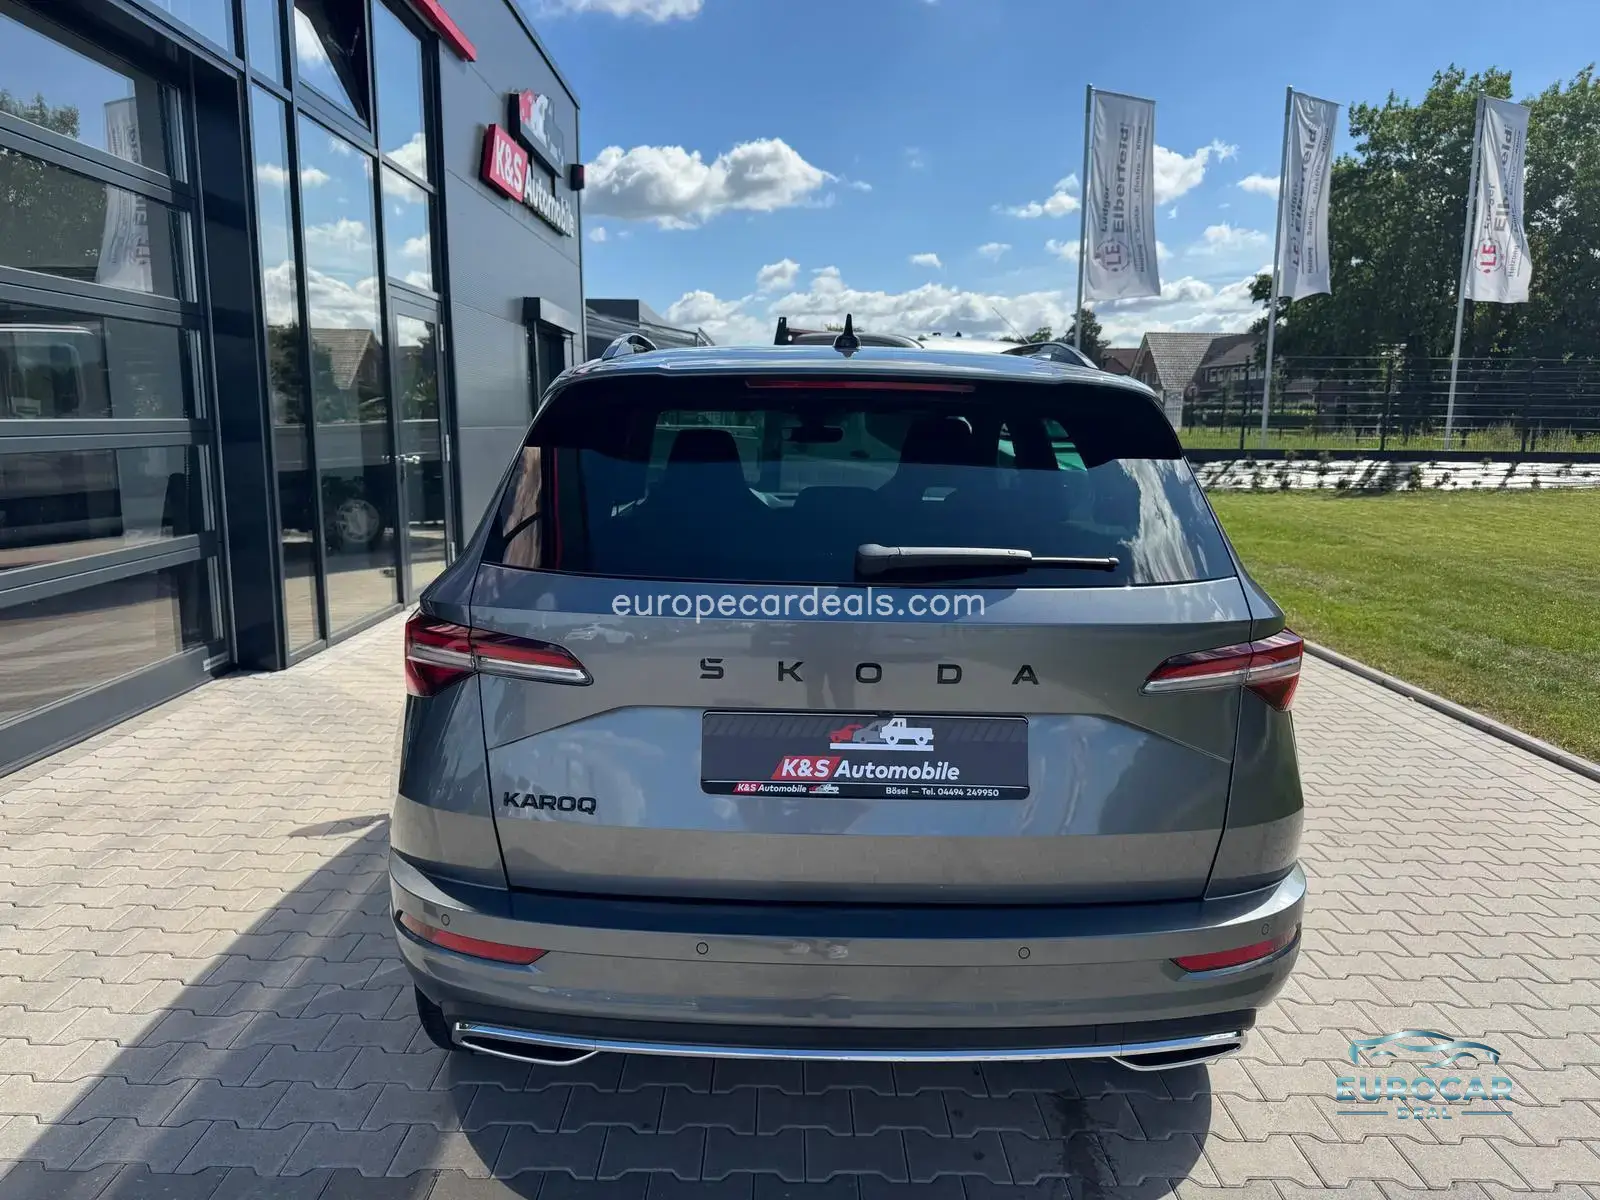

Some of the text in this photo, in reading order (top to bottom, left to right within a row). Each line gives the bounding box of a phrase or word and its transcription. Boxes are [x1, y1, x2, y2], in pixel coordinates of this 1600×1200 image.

[494, 134, 575, 238] K&S Automobile
[1112, 127, 1129, 234] Elberfeld
[1480, 244, 1497, 267] LE
[781, 758, 960, 781] K&S Automobile
[736, 783, 807, 793] K&S Automobile
[885, 786, 909, 796] Bösel
[921, 787, 936, 796] Tel.
[937, 787, 965, 797] 04494
[966, 788, 1000, 798] 249950
[503, 791, 597, 815] KAROQ
